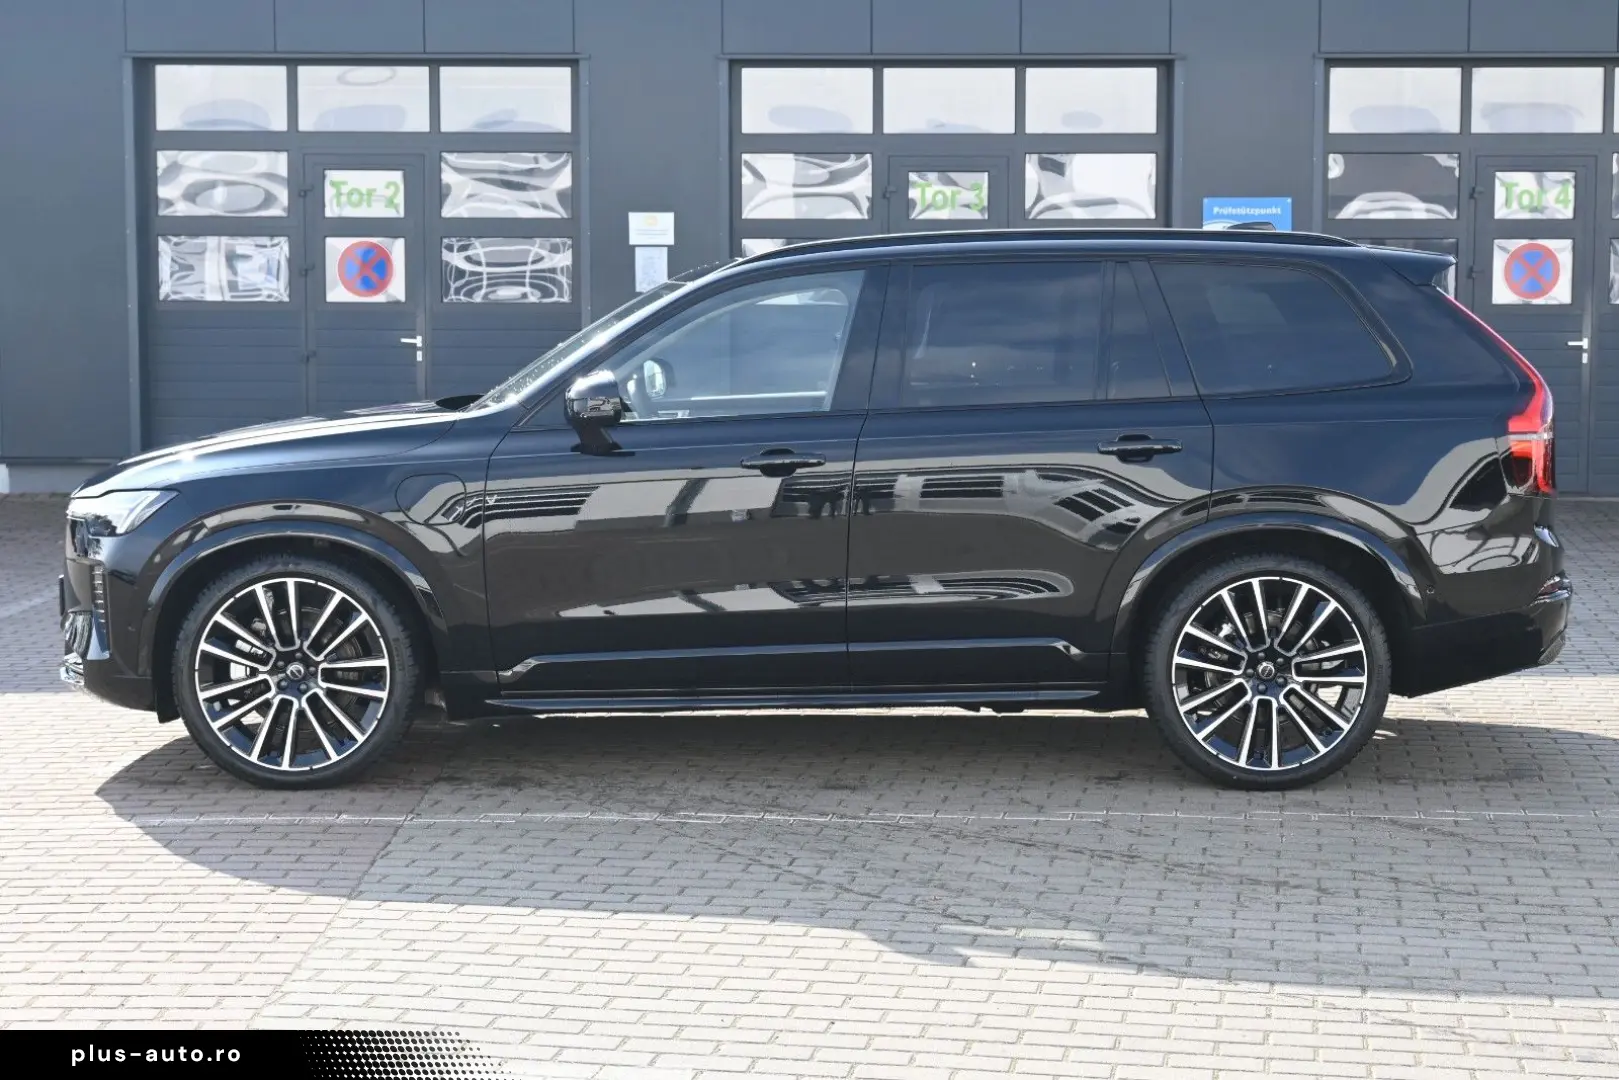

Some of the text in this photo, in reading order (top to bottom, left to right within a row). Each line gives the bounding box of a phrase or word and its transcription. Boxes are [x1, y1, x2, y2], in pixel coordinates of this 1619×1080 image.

[329, 180, 400, 208] Tor 2
[911, 182, 984, 211] Tor 3
[1500, 181, 1571, 210] Tor 4
[1213, 206, 1281, 216] Prüfstützpunkt
